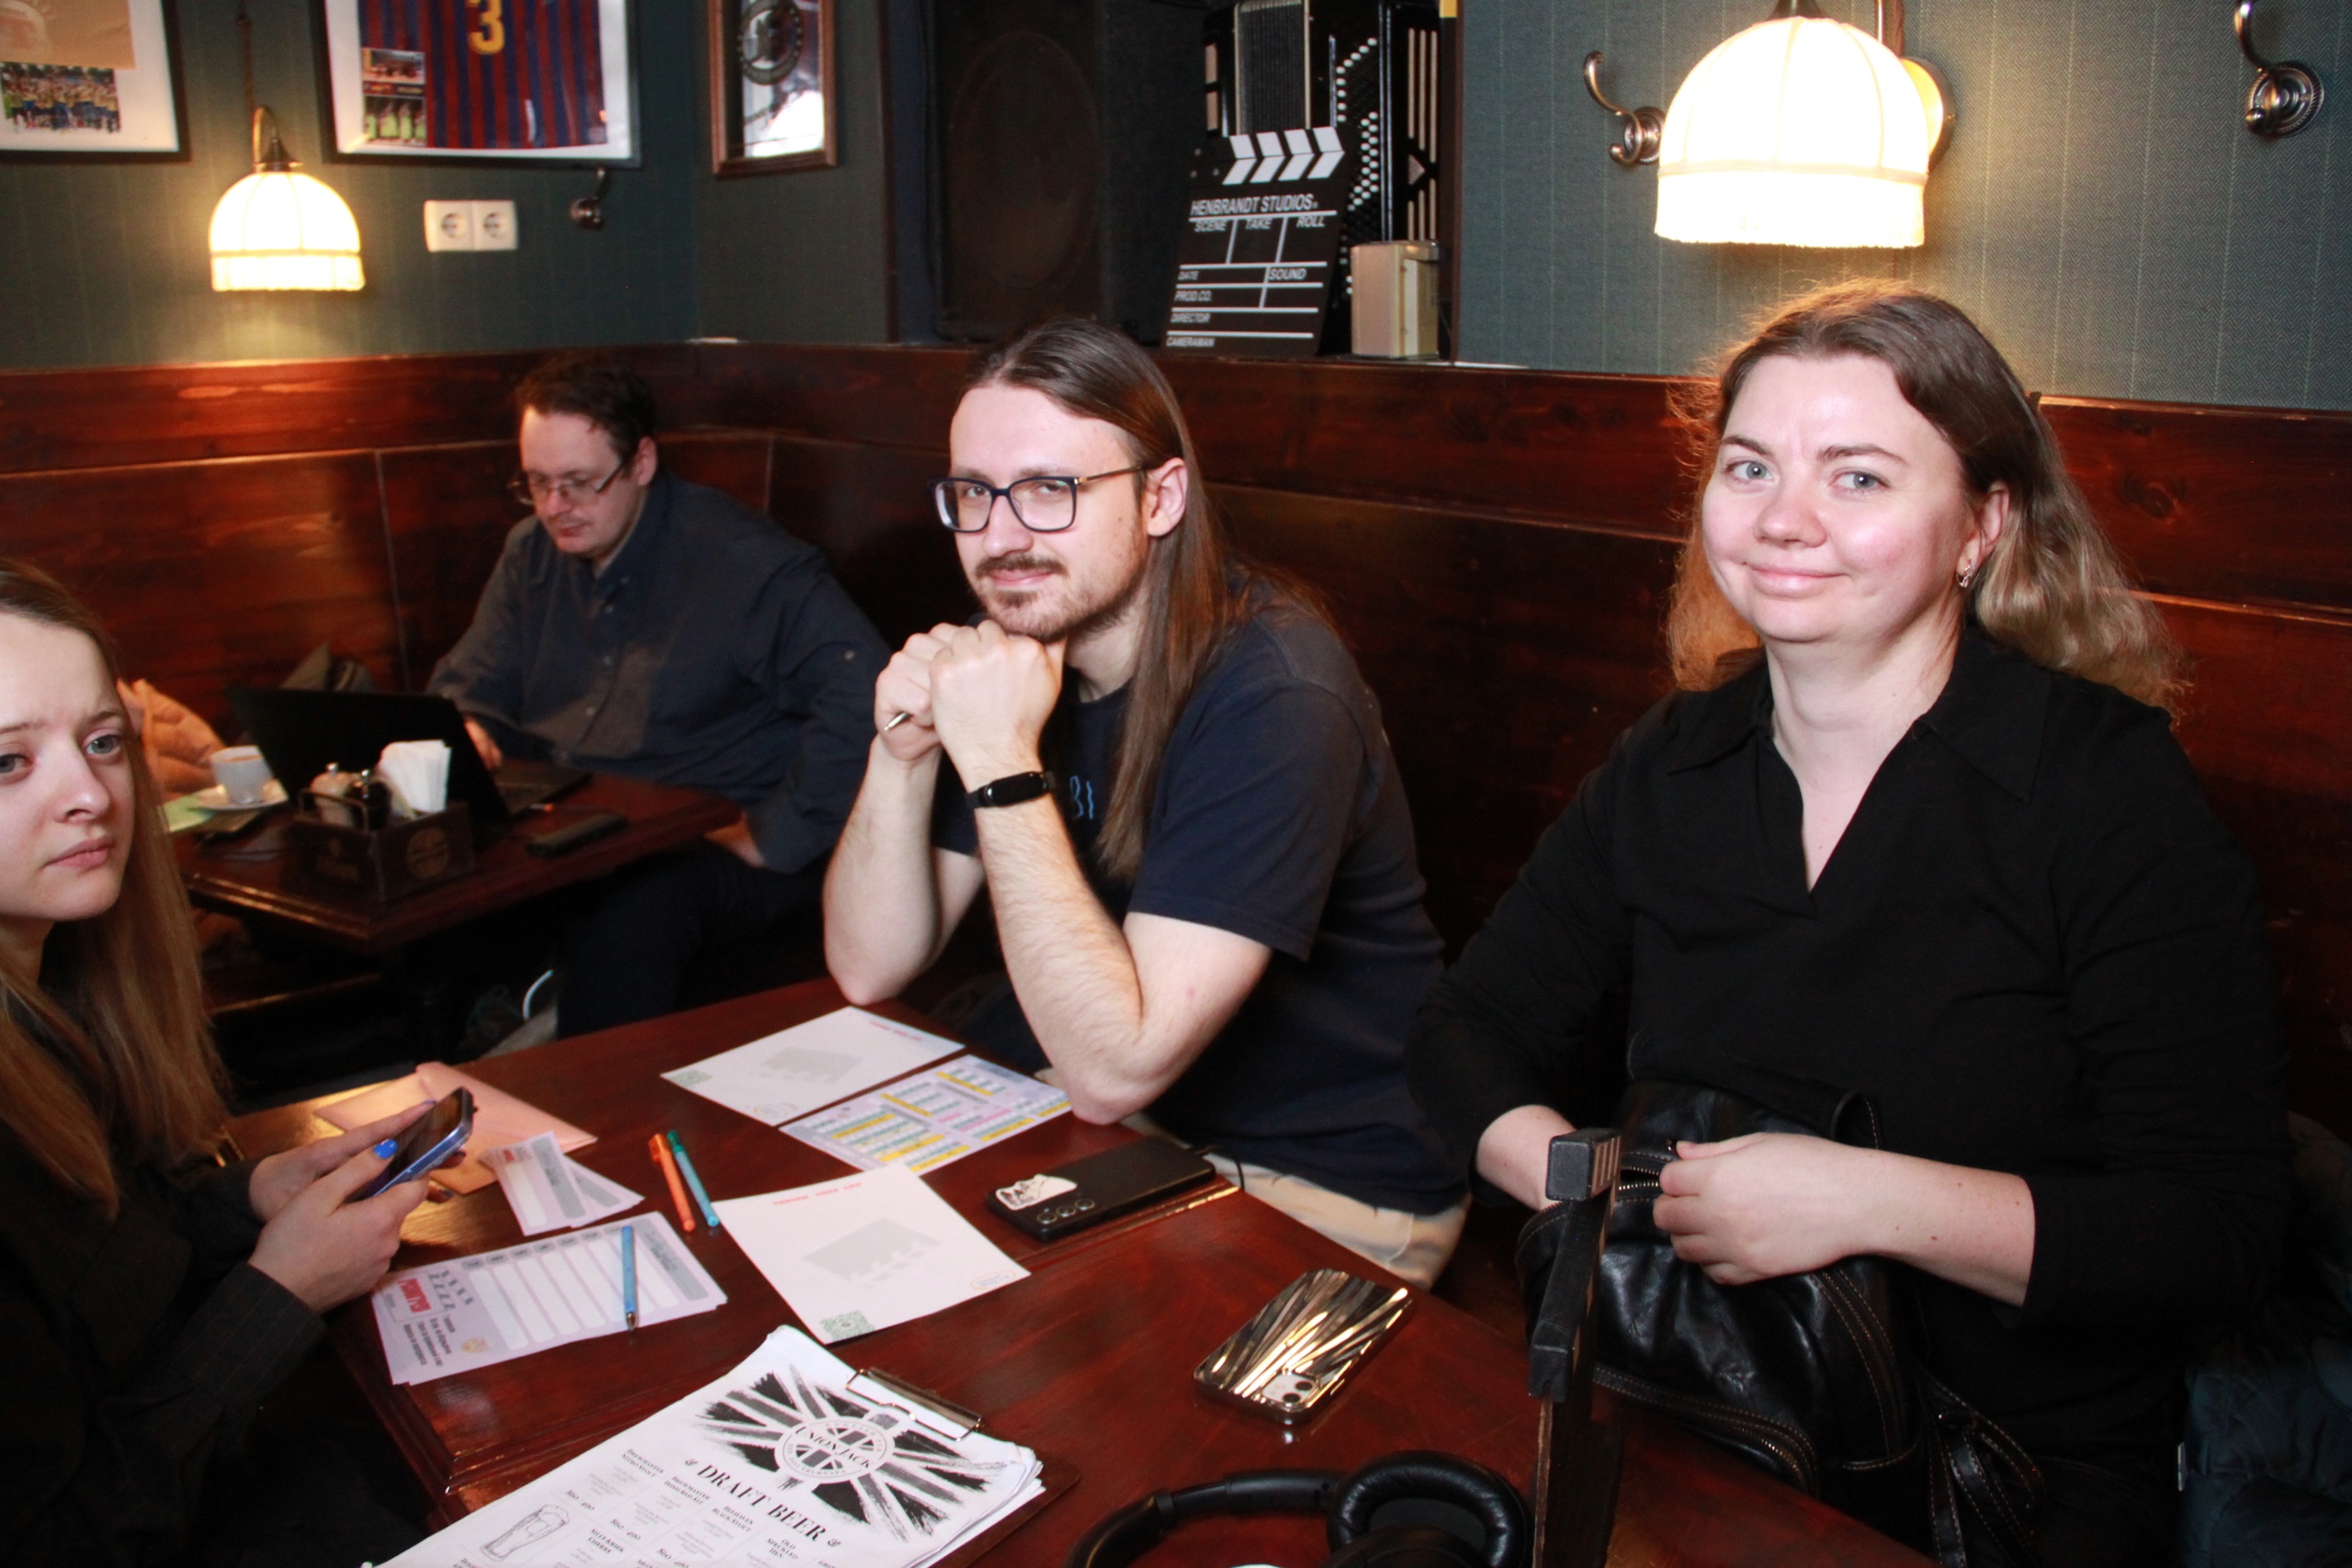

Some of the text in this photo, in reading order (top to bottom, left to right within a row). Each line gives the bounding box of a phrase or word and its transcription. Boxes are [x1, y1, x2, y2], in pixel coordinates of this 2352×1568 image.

[467, 0, 504, 54] 3
[1190, 197, 1260, 216] HENBRANDT
[1194, 219, 1228, 232] SCENE
[1245, 218, 1273, 230] TAKE
[1296, 216, 1325, 228] ROLL
[1178, 271, 1199, 280] DATE
[1269, 268, 1306, 280] SOUND
[1170, 313, 1211, 323] DIRECTOR
[1166, 337, 1215, 347] CAMERAMAN
[795, 1426, 874, 1468] UNION JACK
[697, 1464, 772, 1507] DRAFT
[767, 1504, 827, 1542] BEER
[588, 1537, 612, 1554] CHERRY
[765, 1537, 799, 1560] SPECKLED
[781, 1538, 797, 1551] OLD
